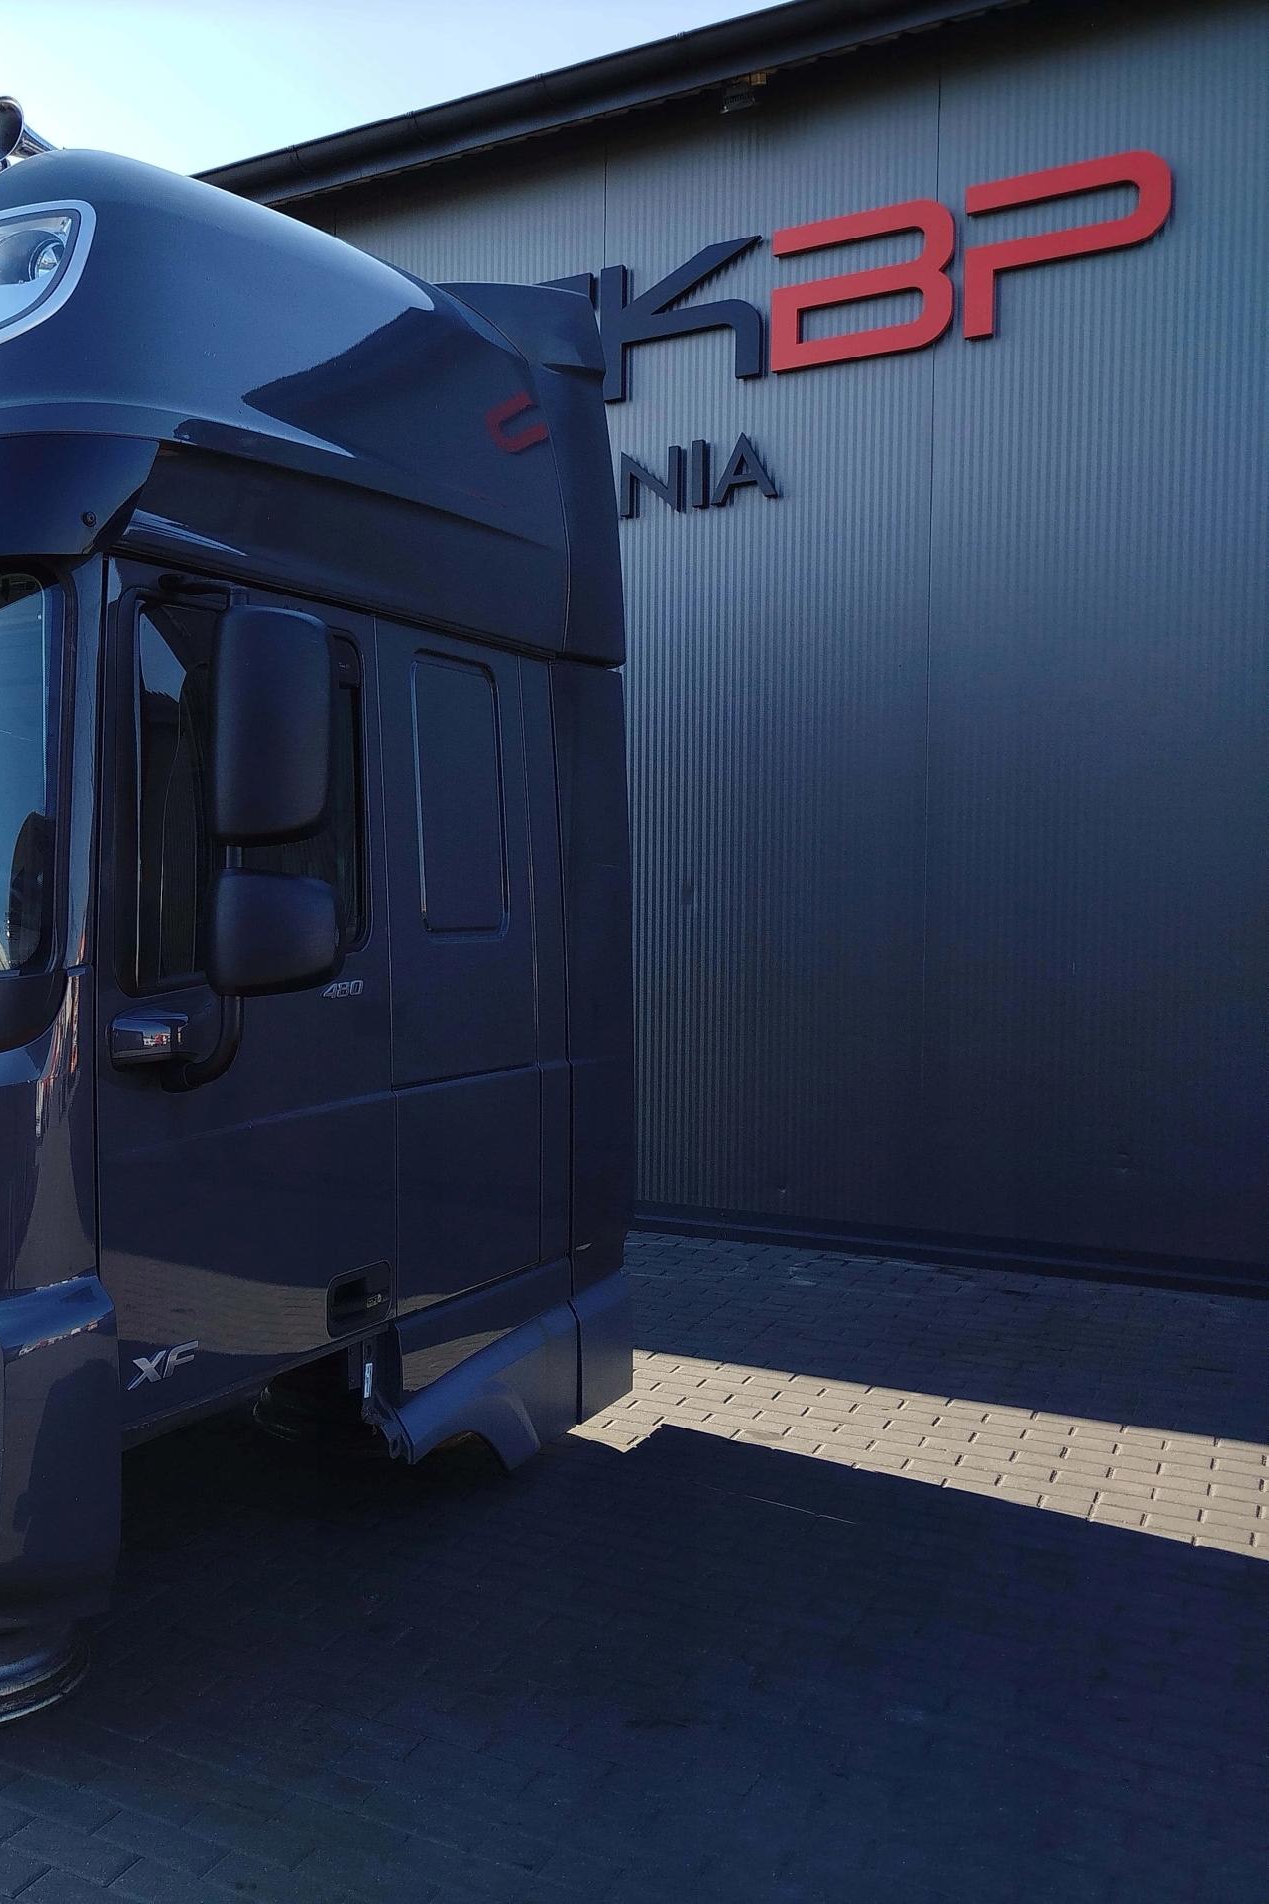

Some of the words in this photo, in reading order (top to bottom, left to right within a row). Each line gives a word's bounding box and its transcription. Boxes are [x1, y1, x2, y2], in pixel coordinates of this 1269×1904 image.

[533, 149, 1173, 403] KBP
[620, 431, 778, 519] NIA
[322, 979, 364, 999] 480
[127, 1339, 199, 1391] XF
